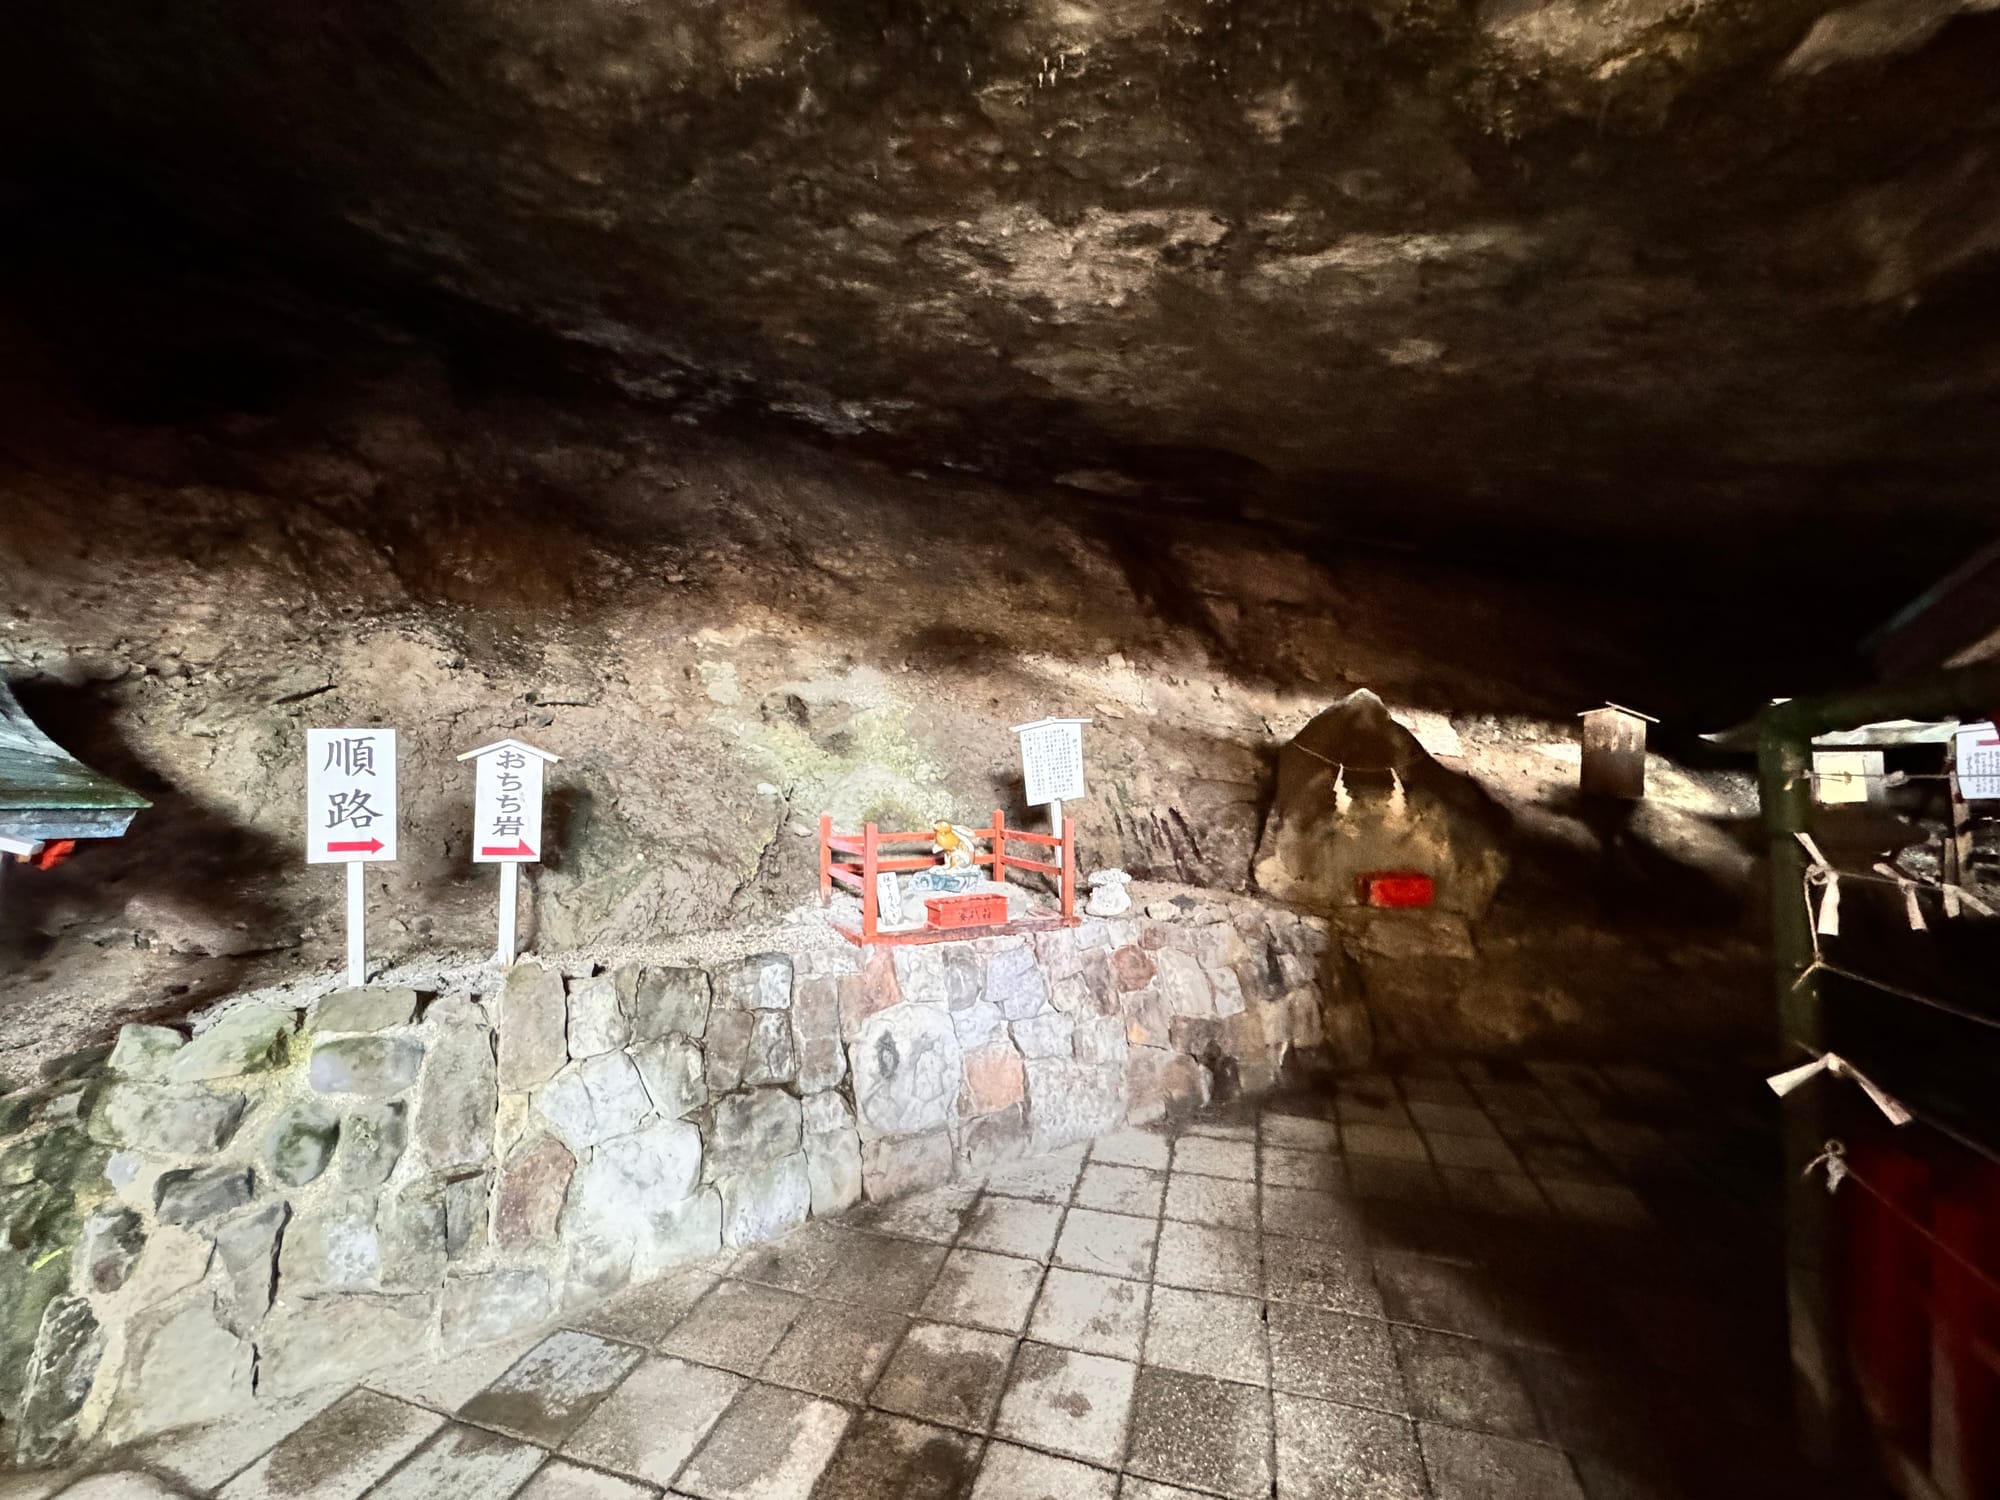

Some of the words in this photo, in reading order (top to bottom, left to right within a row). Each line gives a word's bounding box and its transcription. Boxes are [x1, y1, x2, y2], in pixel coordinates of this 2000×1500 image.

[324, 737, 383, 829] 順路
[492, 751, 525, 836] おちち岩
